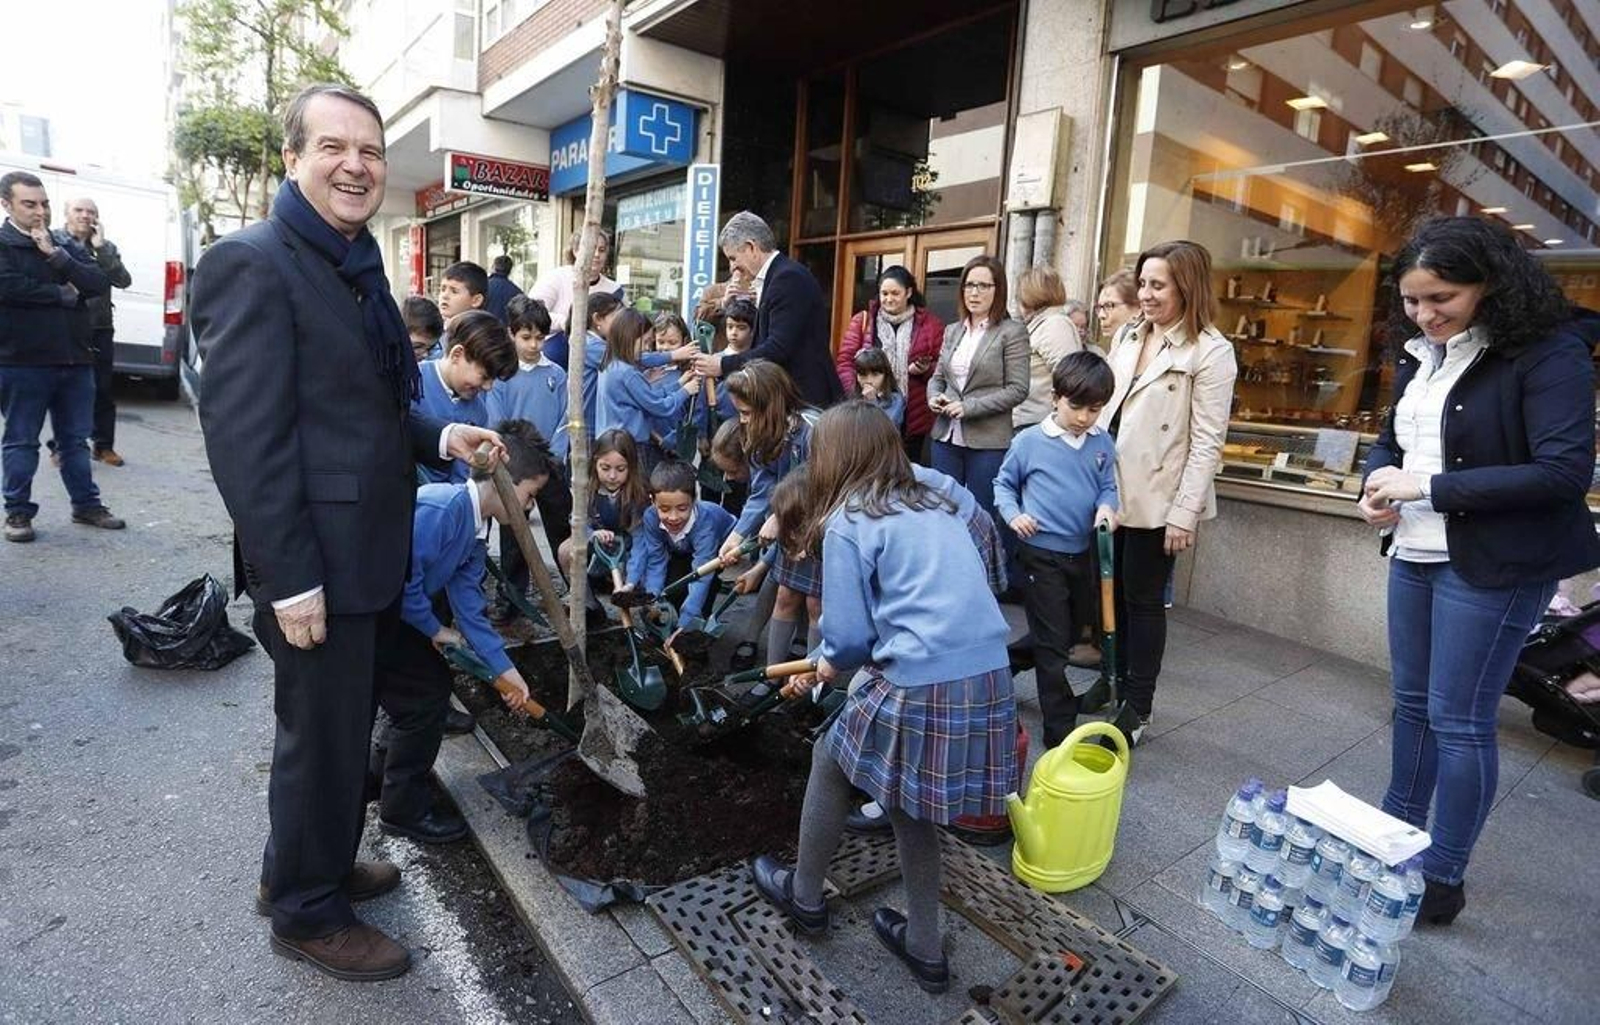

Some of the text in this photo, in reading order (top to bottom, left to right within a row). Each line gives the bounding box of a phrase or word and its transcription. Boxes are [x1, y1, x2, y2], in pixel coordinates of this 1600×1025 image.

[462, 180, 539, 200] Oportunidades
[474, 160, 548, 190] BAZAR
[692, 173, 713, 299] DIETETICA
